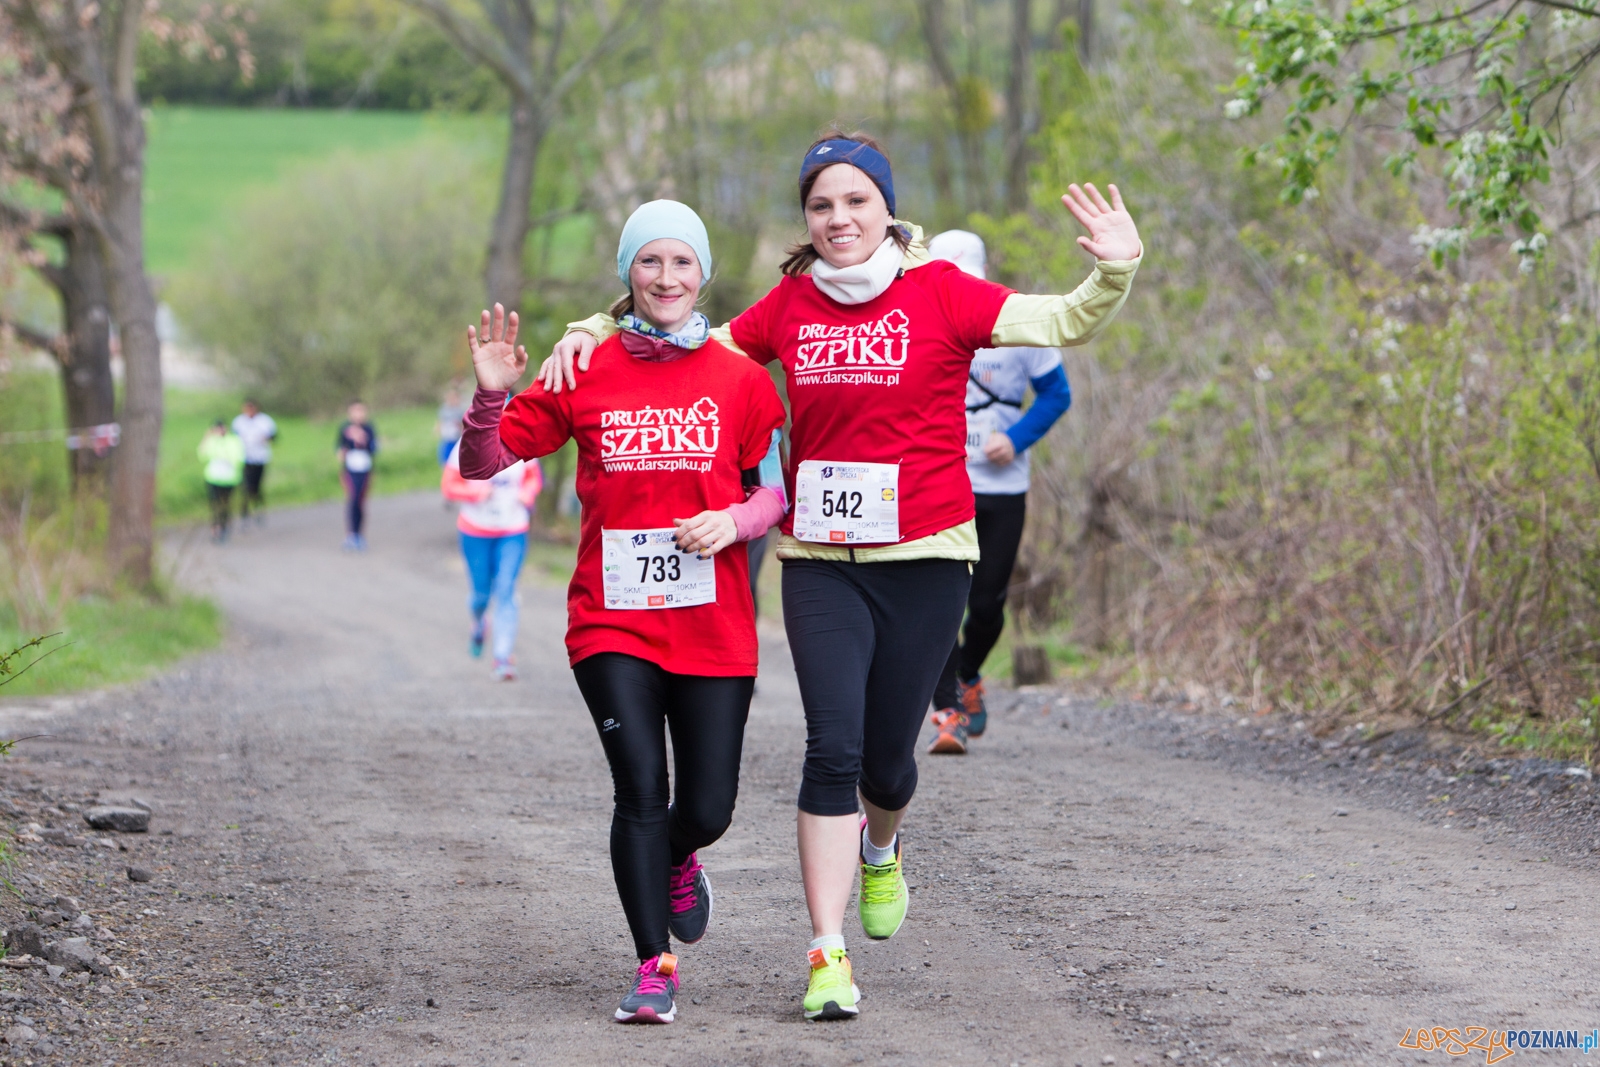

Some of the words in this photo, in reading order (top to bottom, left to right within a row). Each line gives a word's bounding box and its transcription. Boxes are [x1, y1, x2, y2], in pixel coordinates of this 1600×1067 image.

[795, 336, 911, 372] SZPIKU
[796, 371, 900, 387] www.darszpiku.pl
[600, 405, 700, 429] DRUŻYNA
[600, 425, 721, 459] SZPIKU
[604, 458, 713, 474] www.darszpiku.pl
[822, 489, 863, 519] 542
[810, 519, 824, 528] 5KM
[857, 521, 879, 529] 10KM
[636, 554, 682, 584] 733
[623, 586, 641, 594] 5KM
[676, 582, 697, 591] 10KM
